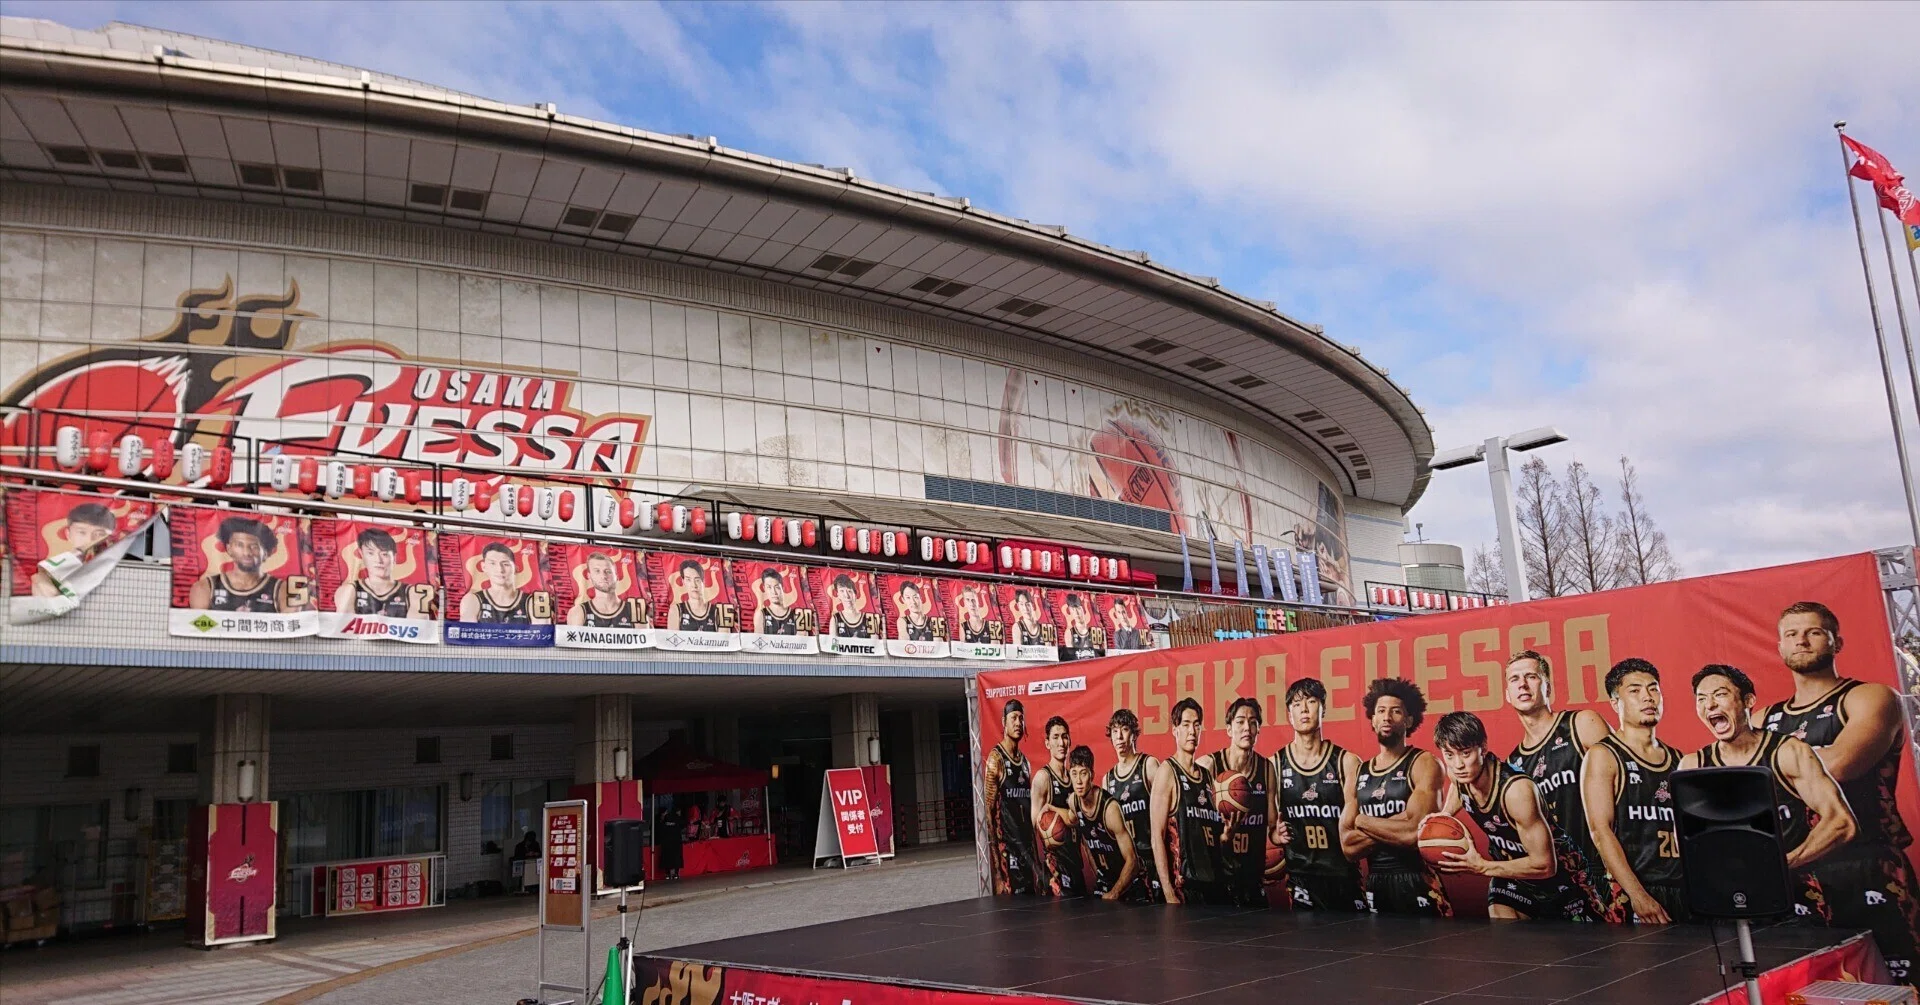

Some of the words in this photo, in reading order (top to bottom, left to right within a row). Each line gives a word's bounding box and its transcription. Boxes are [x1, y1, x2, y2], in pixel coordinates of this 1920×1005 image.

[412, 367, 556, 412] OSAKA
[287, 575, 309, 607] 5
[415, 583, 434, 614] 7
[532, 591, 551, 619] 8
[628, 597, 648, 624] 11
[716, 603, 735, 628] 15
[794, 608, 813, 631] 20
[341, 617, 419, 638] Amosys
[930, 617, 945, 637] 35
[988, 621, 1003, 640] 52
[1041, 623, 1054, 642] 60
[1091, 626, 1103, 645] 88
[579, 630, 647, 645] YANAGIMOTO
[686, 635, 730, 648] Nakamura
[769, 639, 808, 651] Nakamura
[838, 642, 876, 655] HAMTEC
[1112, 653, 1290, 734] OSAKA
[1319, 612, 1613, 722] EVESSA
[985, 685, 1017, 699] SUPPORTED
[1018, 684, 1026, 695] BY
[1044, 679, 1082, 692] INFINITY
[1538, 769, 1577, 795] man
[835, 789, 863, 806] VIP
[1121, 799, 1146, 815] man
[840, 809, 866, 822] 関係者
[1628, 805, 1675, 822] Hum
[847, 823, 864, 835] 受付
[1305, 825, 1329, 849] 88
[1232, 832, 1249, 854] 60
[1489, 834, 1531, 858] man
